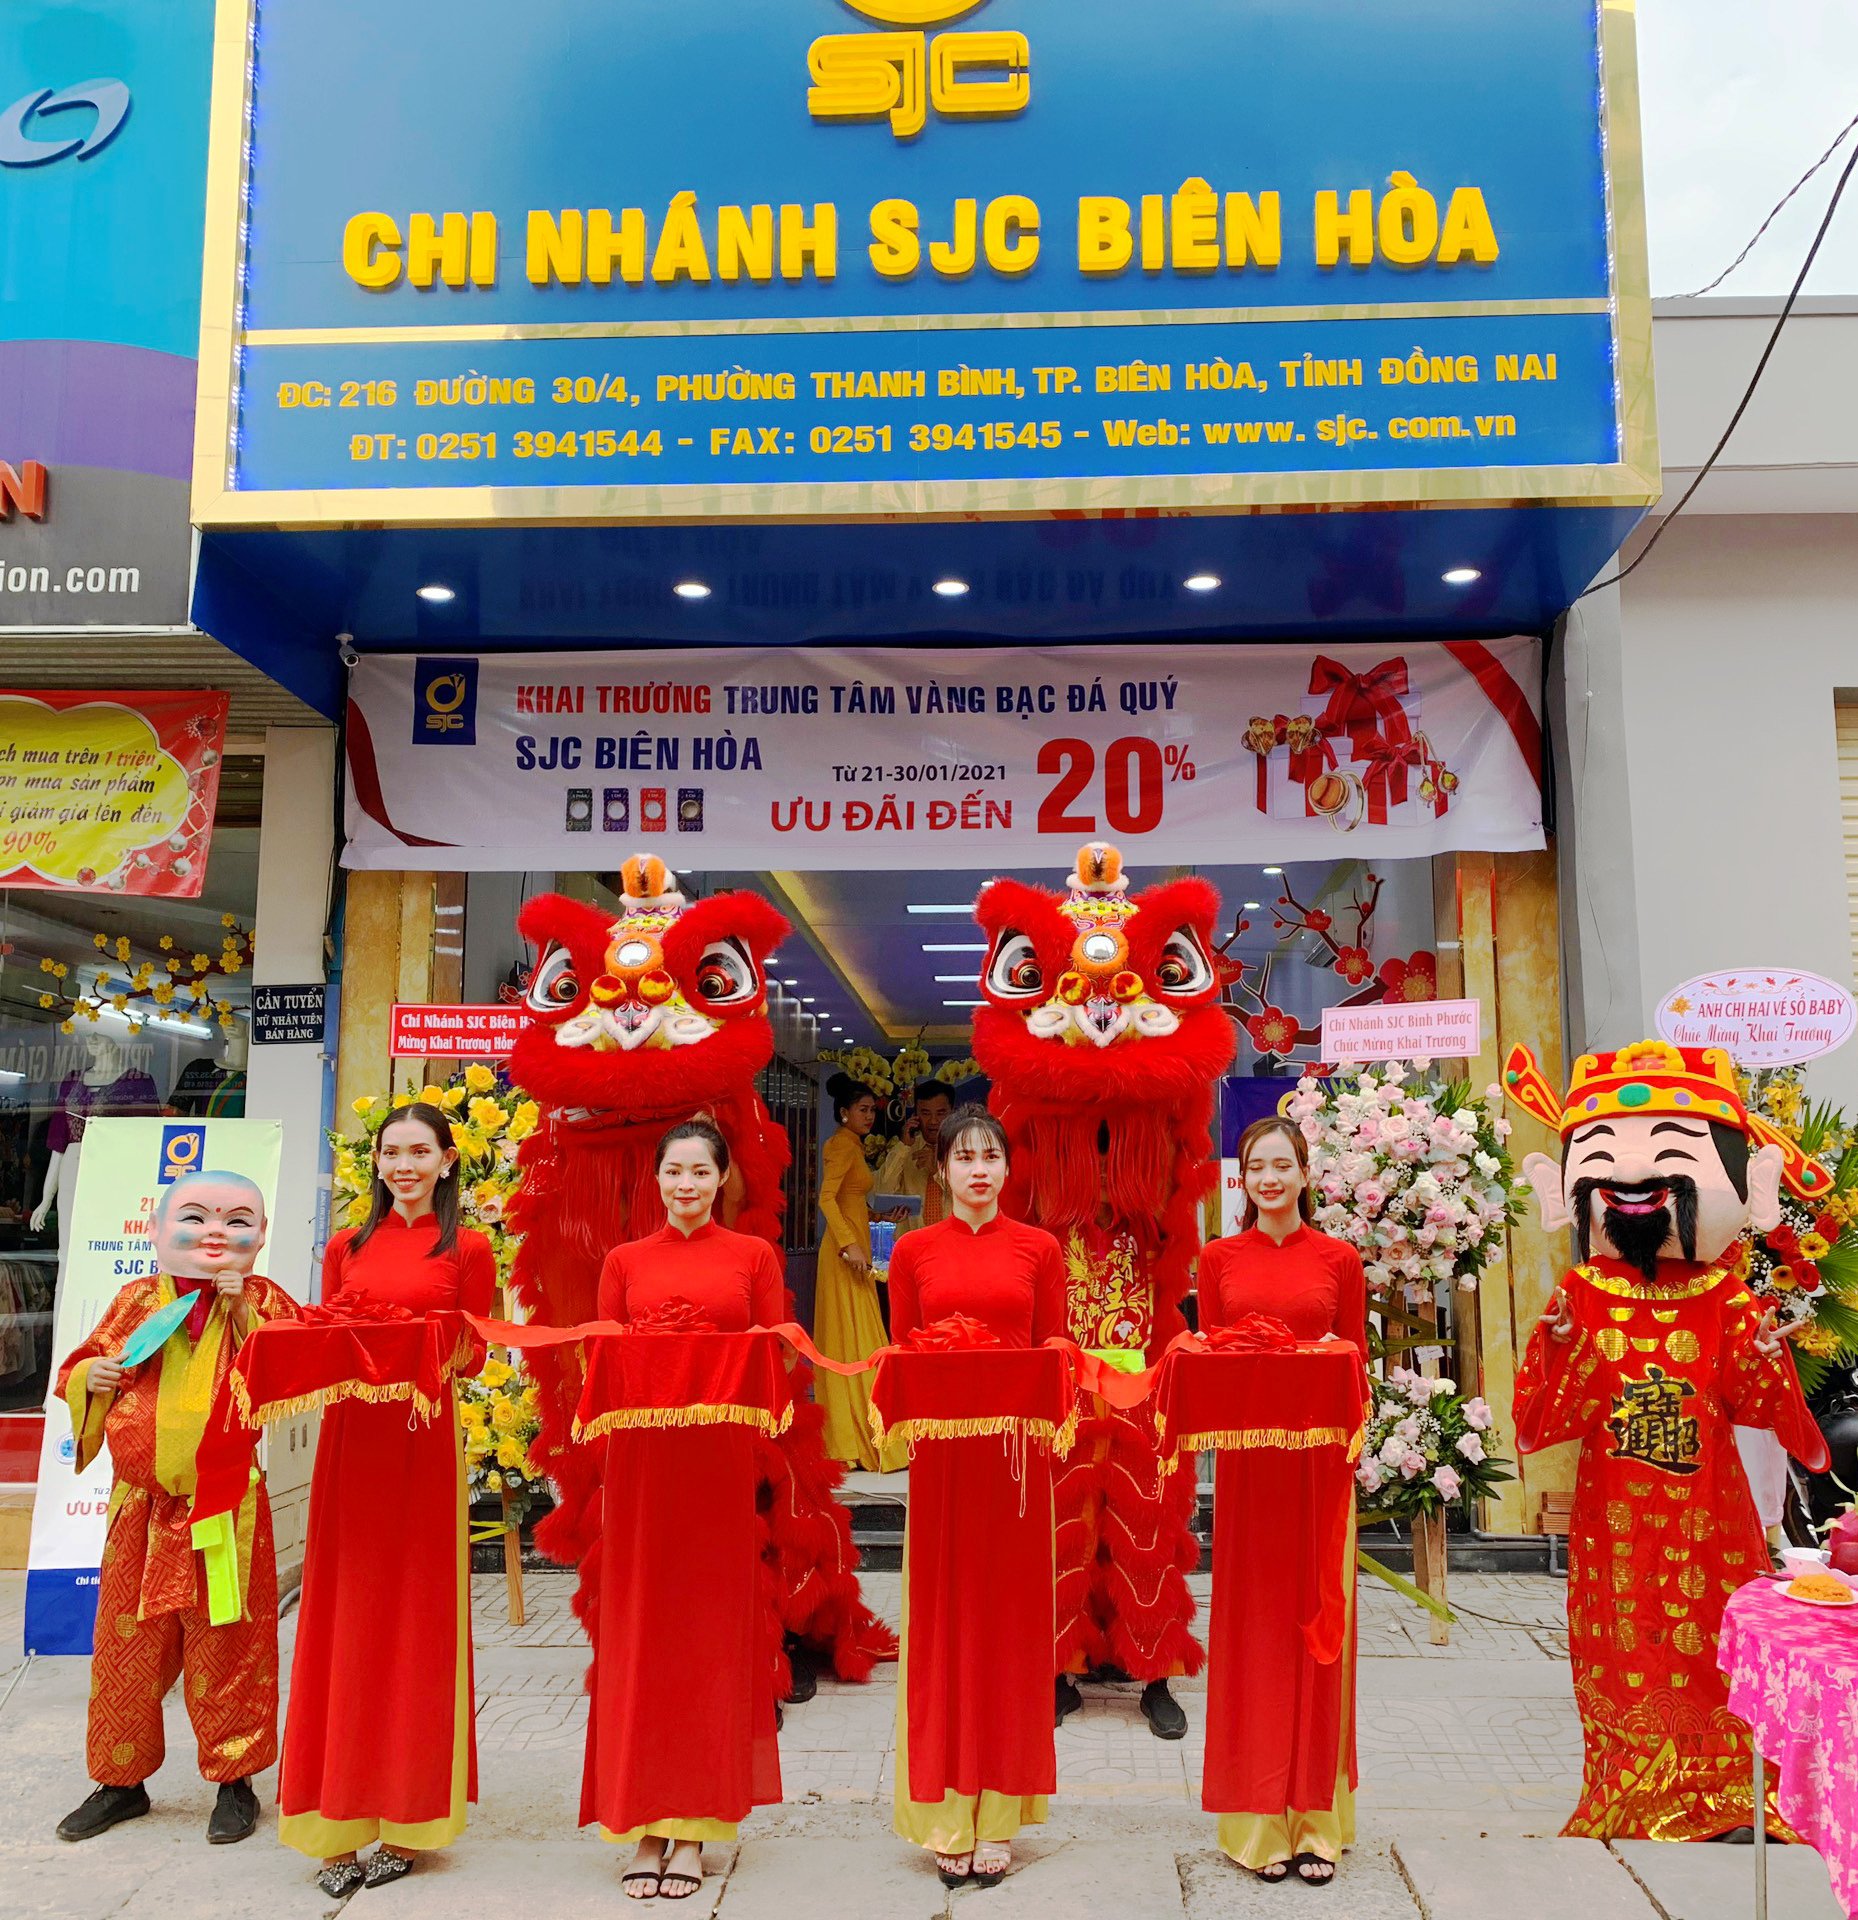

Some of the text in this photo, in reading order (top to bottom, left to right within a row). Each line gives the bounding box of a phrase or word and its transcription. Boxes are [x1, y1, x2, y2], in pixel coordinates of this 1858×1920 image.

[343, 170, 1500, 288] CHI NHÁNH SJC BIÊN HÒA
[277, 345, 1558, 410] ĐC: 216 ĐƯỜNG 30/4, PHƯỜNG THANH BÌNH, TP. BIÊN HÒA, TỈNH ĐỒNG NAI
[349, 433, 407, 462] ĐT:
[416, 432, 498, 461] 0251
[513, 429, 663, 459] 3941544
[710, 427, 795, 457] FAX:
[810, 424, 893, 455] 0251
[909, 420, 1063, 452] 3941545
[1102, 418, 1191, 448] Web:
[1203, 419, 1306, 444] www.
[1316, 413, 1379, 447] sjc.
[517, 673, 1179, 721] KHAI TRƯƠNG TRUNG TÂM VÀNG BẠC ĐÁ QUÝ
[22, 749, 60, 764] mua
[65, 747, 100, 765] trên
[516, 728, 763, 771] SJC BIÊN HÒA
[25, 776, 62, 790] mua
[70, 772, 100, 791] sản
[104, 770, 155, 795] phẩm
[832, 762, 1007, 784] Từ 21-30/01/2021
[10, 801, 55, 824] giảm
[58, 802, 89, 826] giá
[94, 803, 122, 823] lên
[130, 802, 163, 824] đến
[771, 795, 832, 832] ƯU
[843, 793, 915, 831] ĐÃI
[926, 788, 1013, 831] ĐẾN
[2, 830, 57, 857] 90%
[256, 987, 324, 1010] CẦN TUYỂN
[1696, 992, 1847, 1022] ANH CHỊ HAI VÉ SỐ BABY
[256, 1012, 323, 1027] NỮ NHÂN VIÊN
[401, 1014, 422, 1029] Chi
[423, 1014, 464, 1029] Nhánh
[466, 1015, 487, 1029] SJC
[489, 1014, 517, 1029] Biên
[1348, 1015, 1384, 1031] Nhánh
[1386, 1015, 1406, 1029] SJC
[1436, 1010, 1473, 1026] Phước
[265, 1026, 314, 1040] BÁN HÀNG
[398, 1032, 517, 1053] Mừng Khai Trương Hồn
[1333, 1037, 1360, 1053] Chúc
[1425, 1033, 1467, 1050] Trương
[1673, 1022, 1701, 1043] Chúc
[1744, 1022, 1779, 1044] Khai
[88, 1238, 152, 1251] TRUNG TÂM
[114, 1259, 144, 1275] SJC
